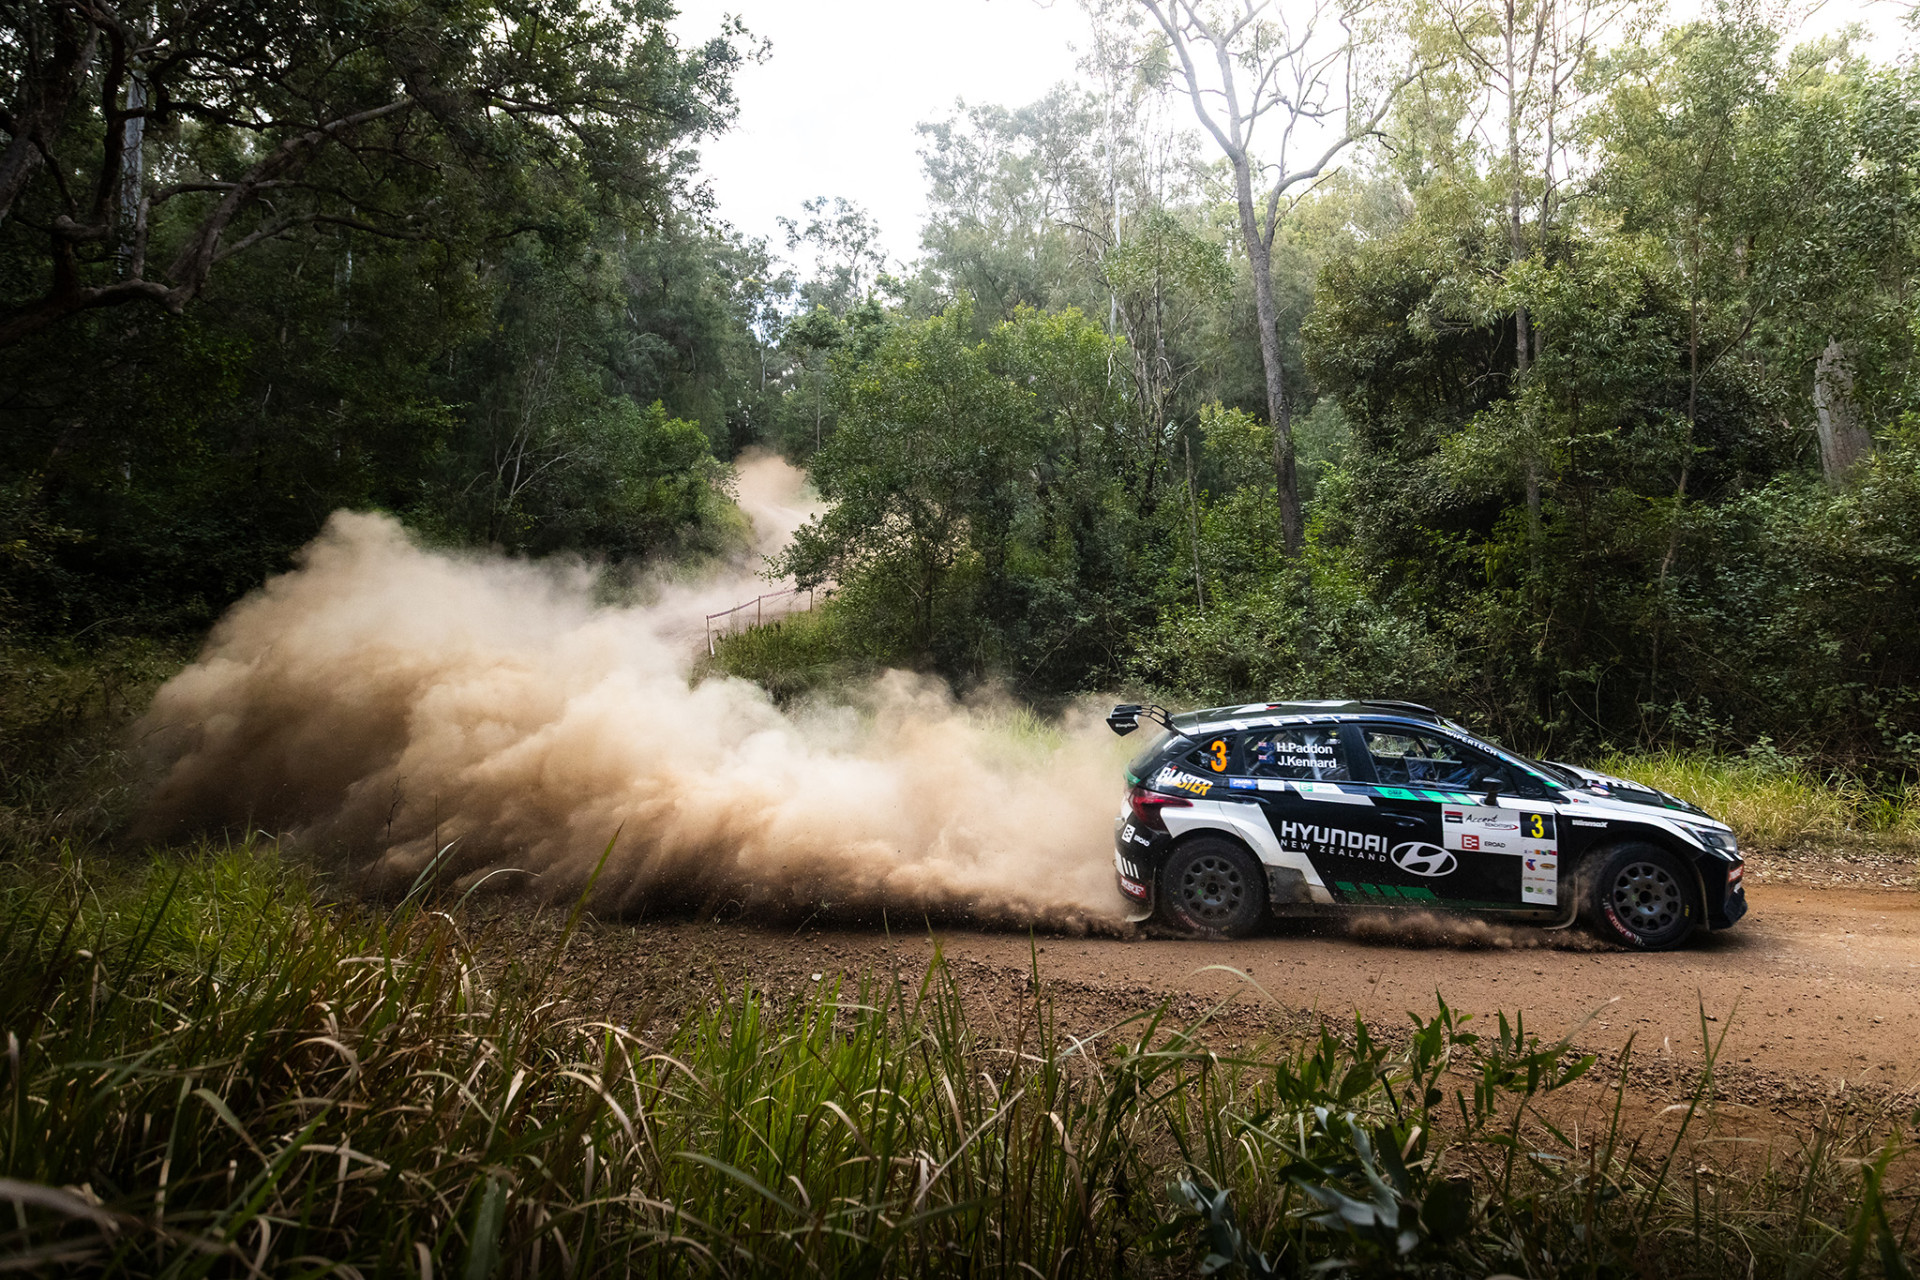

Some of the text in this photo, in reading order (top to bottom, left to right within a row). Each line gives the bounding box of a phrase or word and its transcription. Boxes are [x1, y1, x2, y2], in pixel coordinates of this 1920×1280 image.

[1210, 740, 1227, 772] 3
[1276, 741, 1333, 755] H.Paddon
[1445, 730, 1498, 757] WIPERTECH
[1277, 755, 1337, 769] J.Kennard
[1155, 765, 1214, 797] BLASTER
[1465, 814, 1498, 823] Accent
[1530, 814, 1545, 839] 3
[1281, 820, 1388, 854] HYUNDAI
[1484, 840, 1506, 849] EROAD
[1280, 838, 1387, 863] NEW ZEALAND
